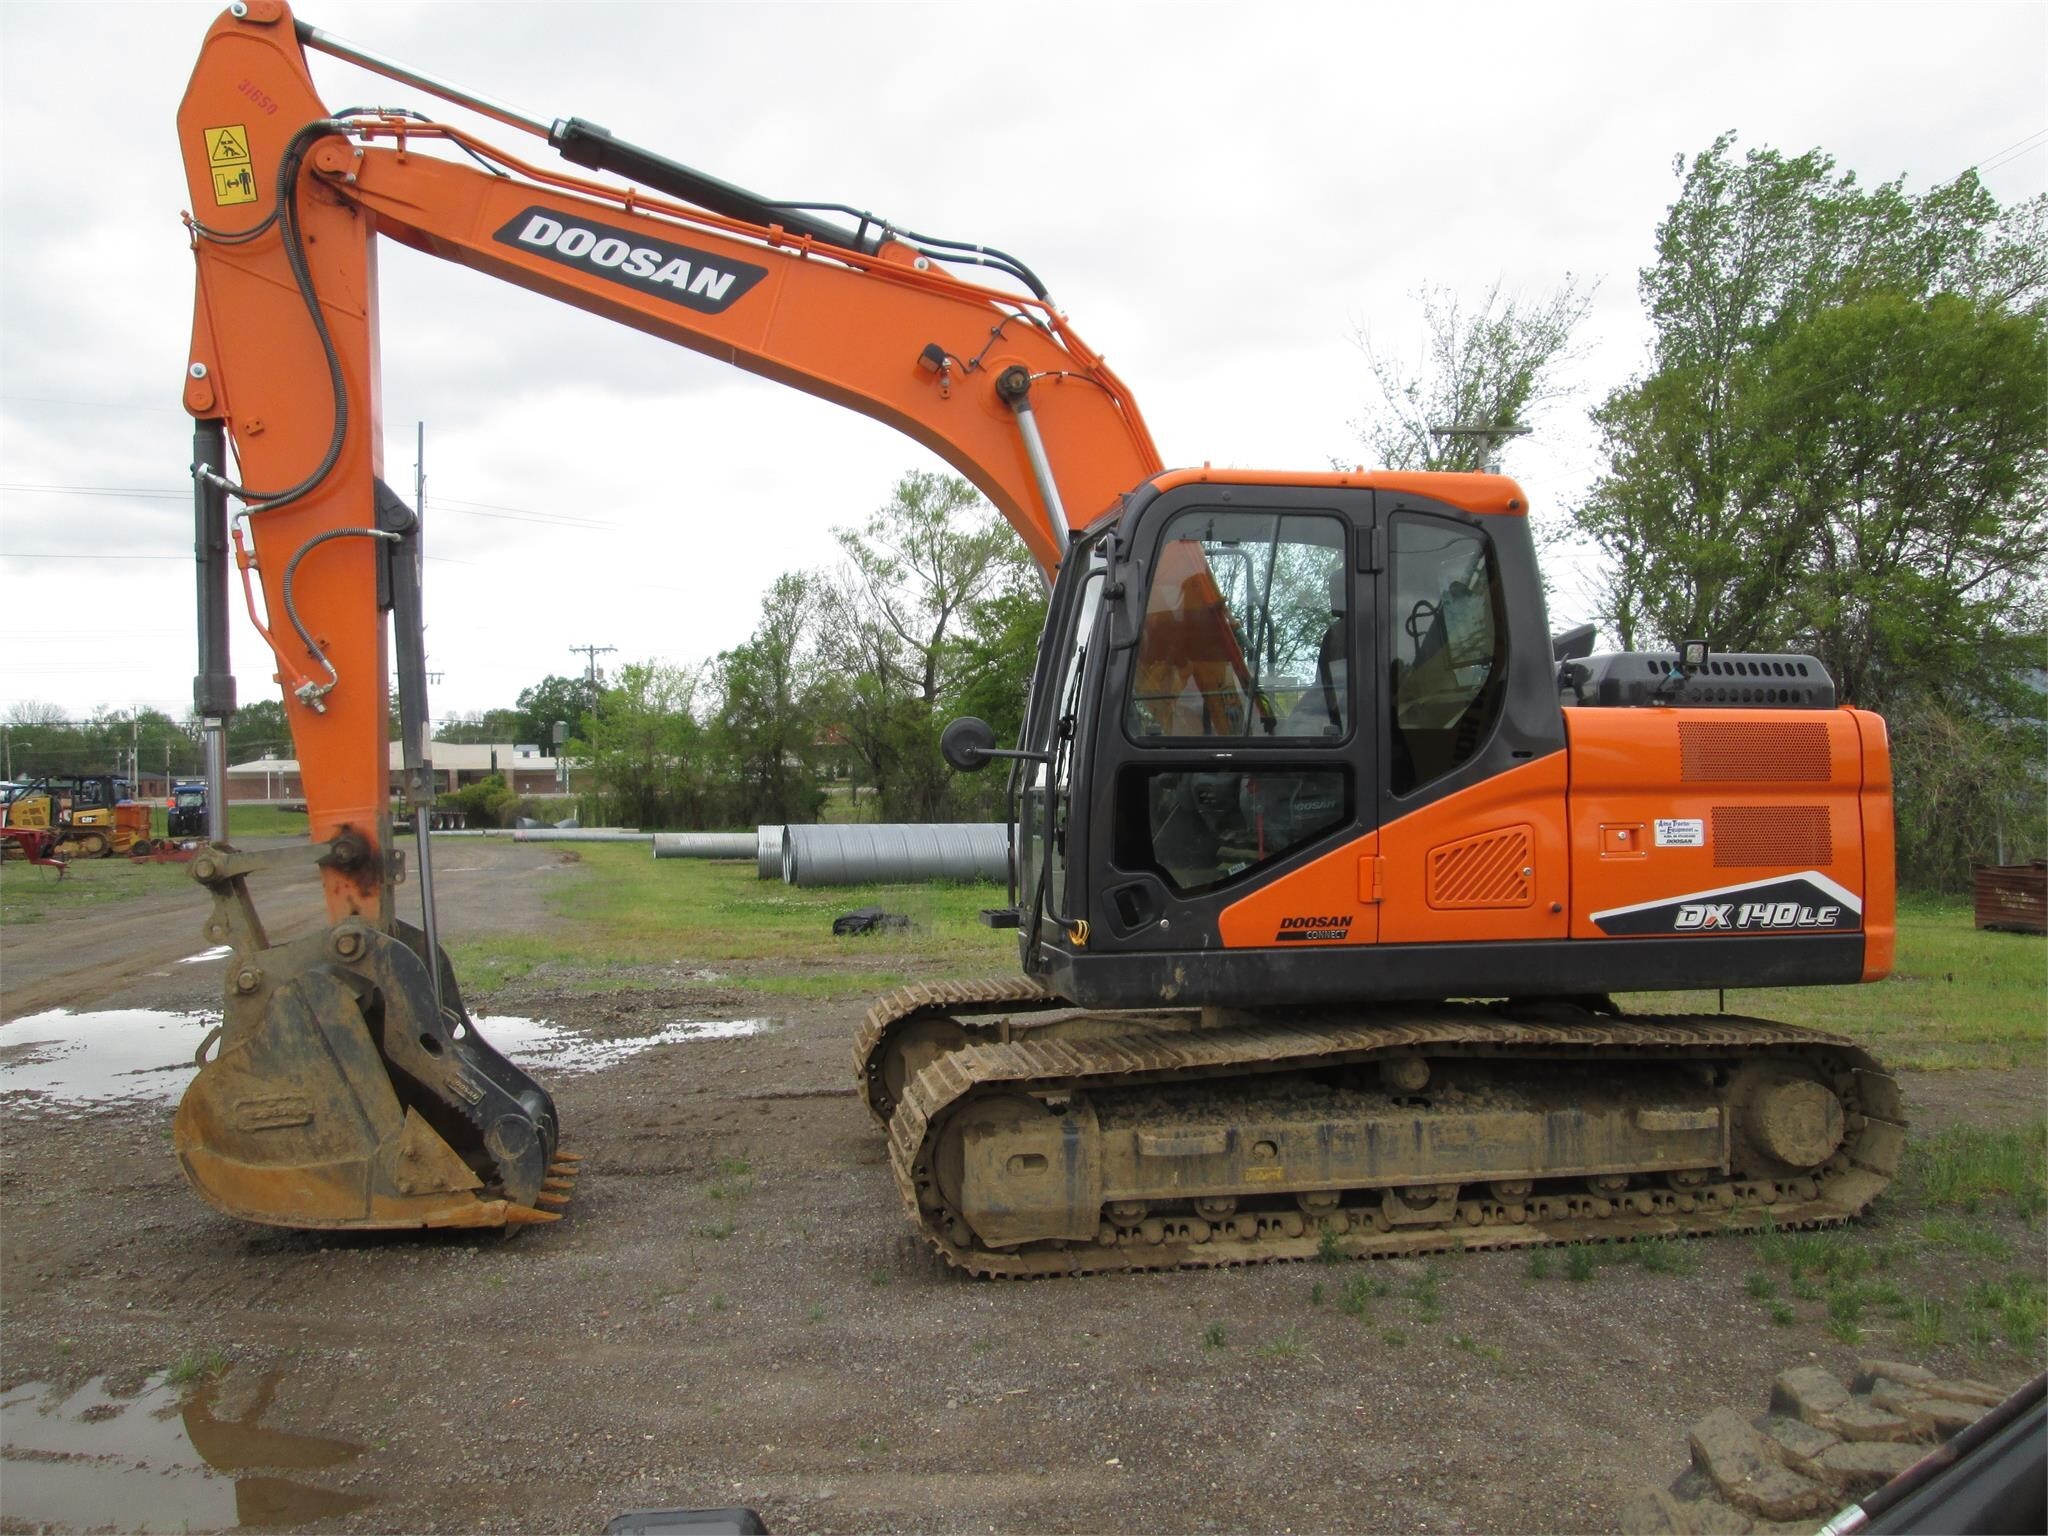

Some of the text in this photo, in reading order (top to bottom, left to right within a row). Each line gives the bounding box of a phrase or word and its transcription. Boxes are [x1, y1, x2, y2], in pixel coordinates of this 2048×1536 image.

[518, 215, 736, 300] DOOSAN
[1280, 916, 1353, 929] DOOSAN
[1675, 903, 1734, 929] DX
[1306, 930, 1346, 939] CONNECT
